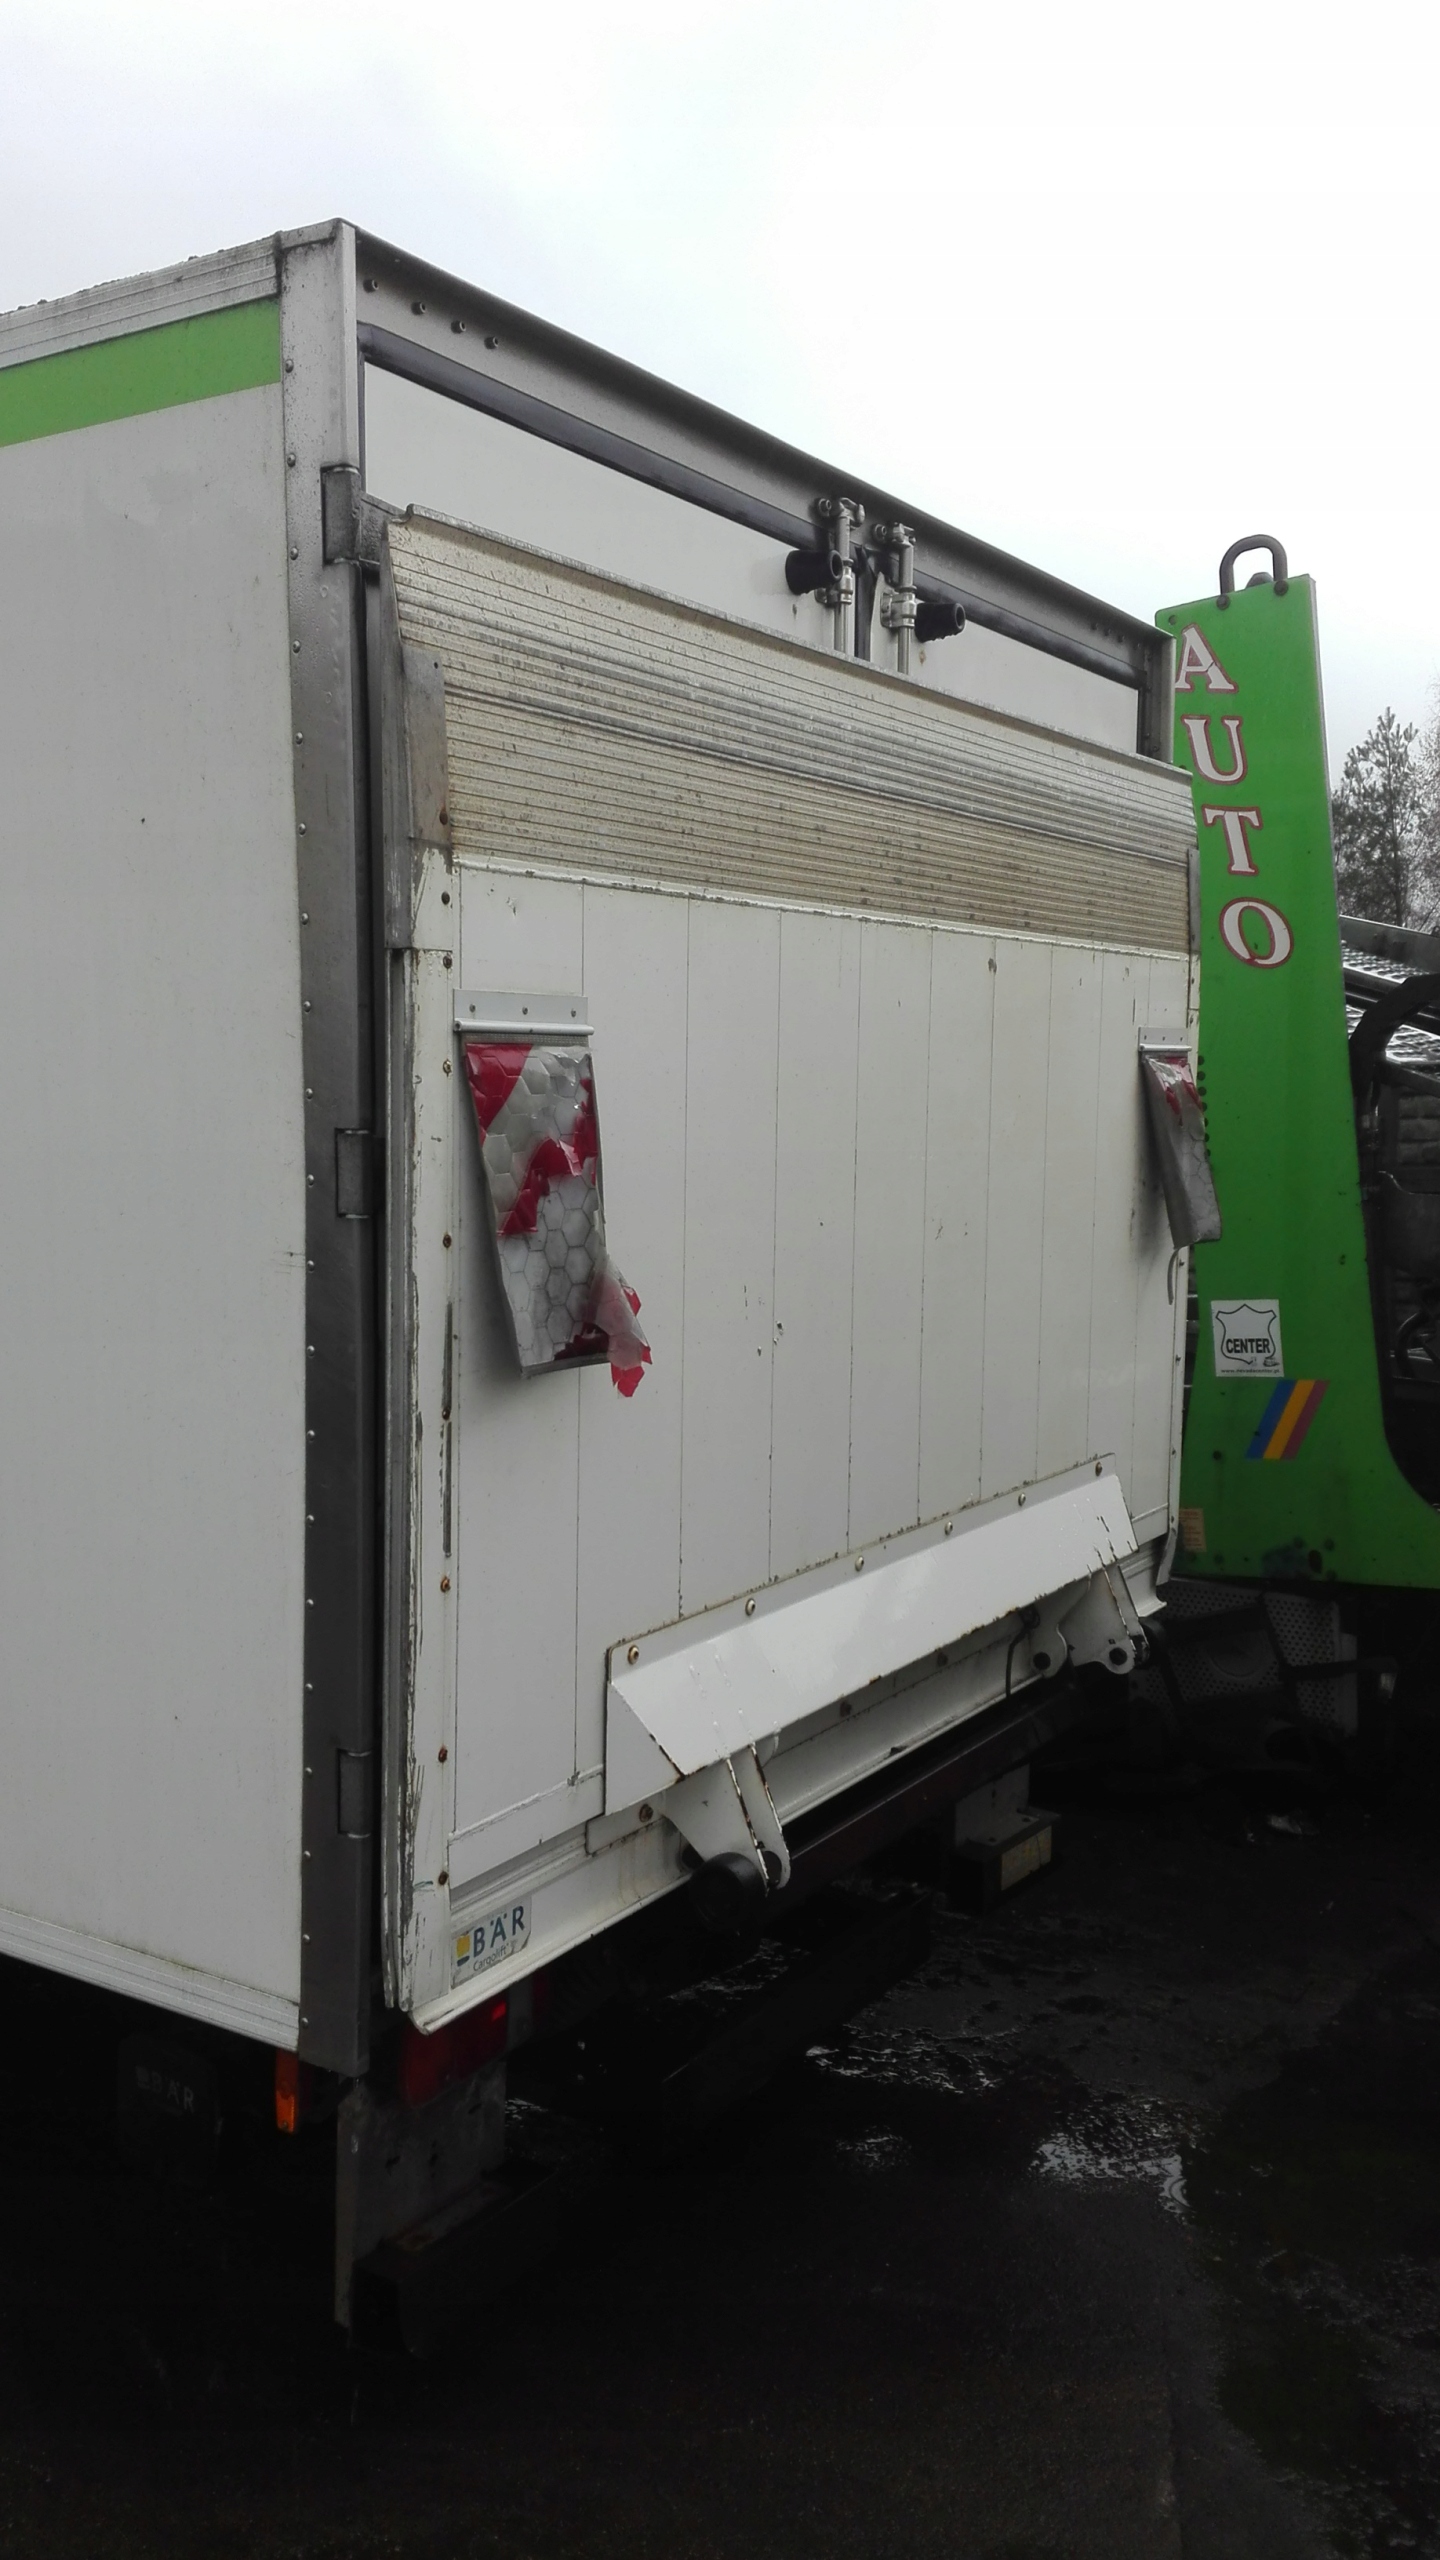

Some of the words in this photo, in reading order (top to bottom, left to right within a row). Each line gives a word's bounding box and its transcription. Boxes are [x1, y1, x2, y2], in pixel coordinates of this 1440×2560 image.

[1175, 623, 1294, 969] AUTO
[1226, 1338, 1270, 1353] CENTER
[473, 1905, 526, 1958] BÄR
[473, 1943, 508, 1971] Cargolift
